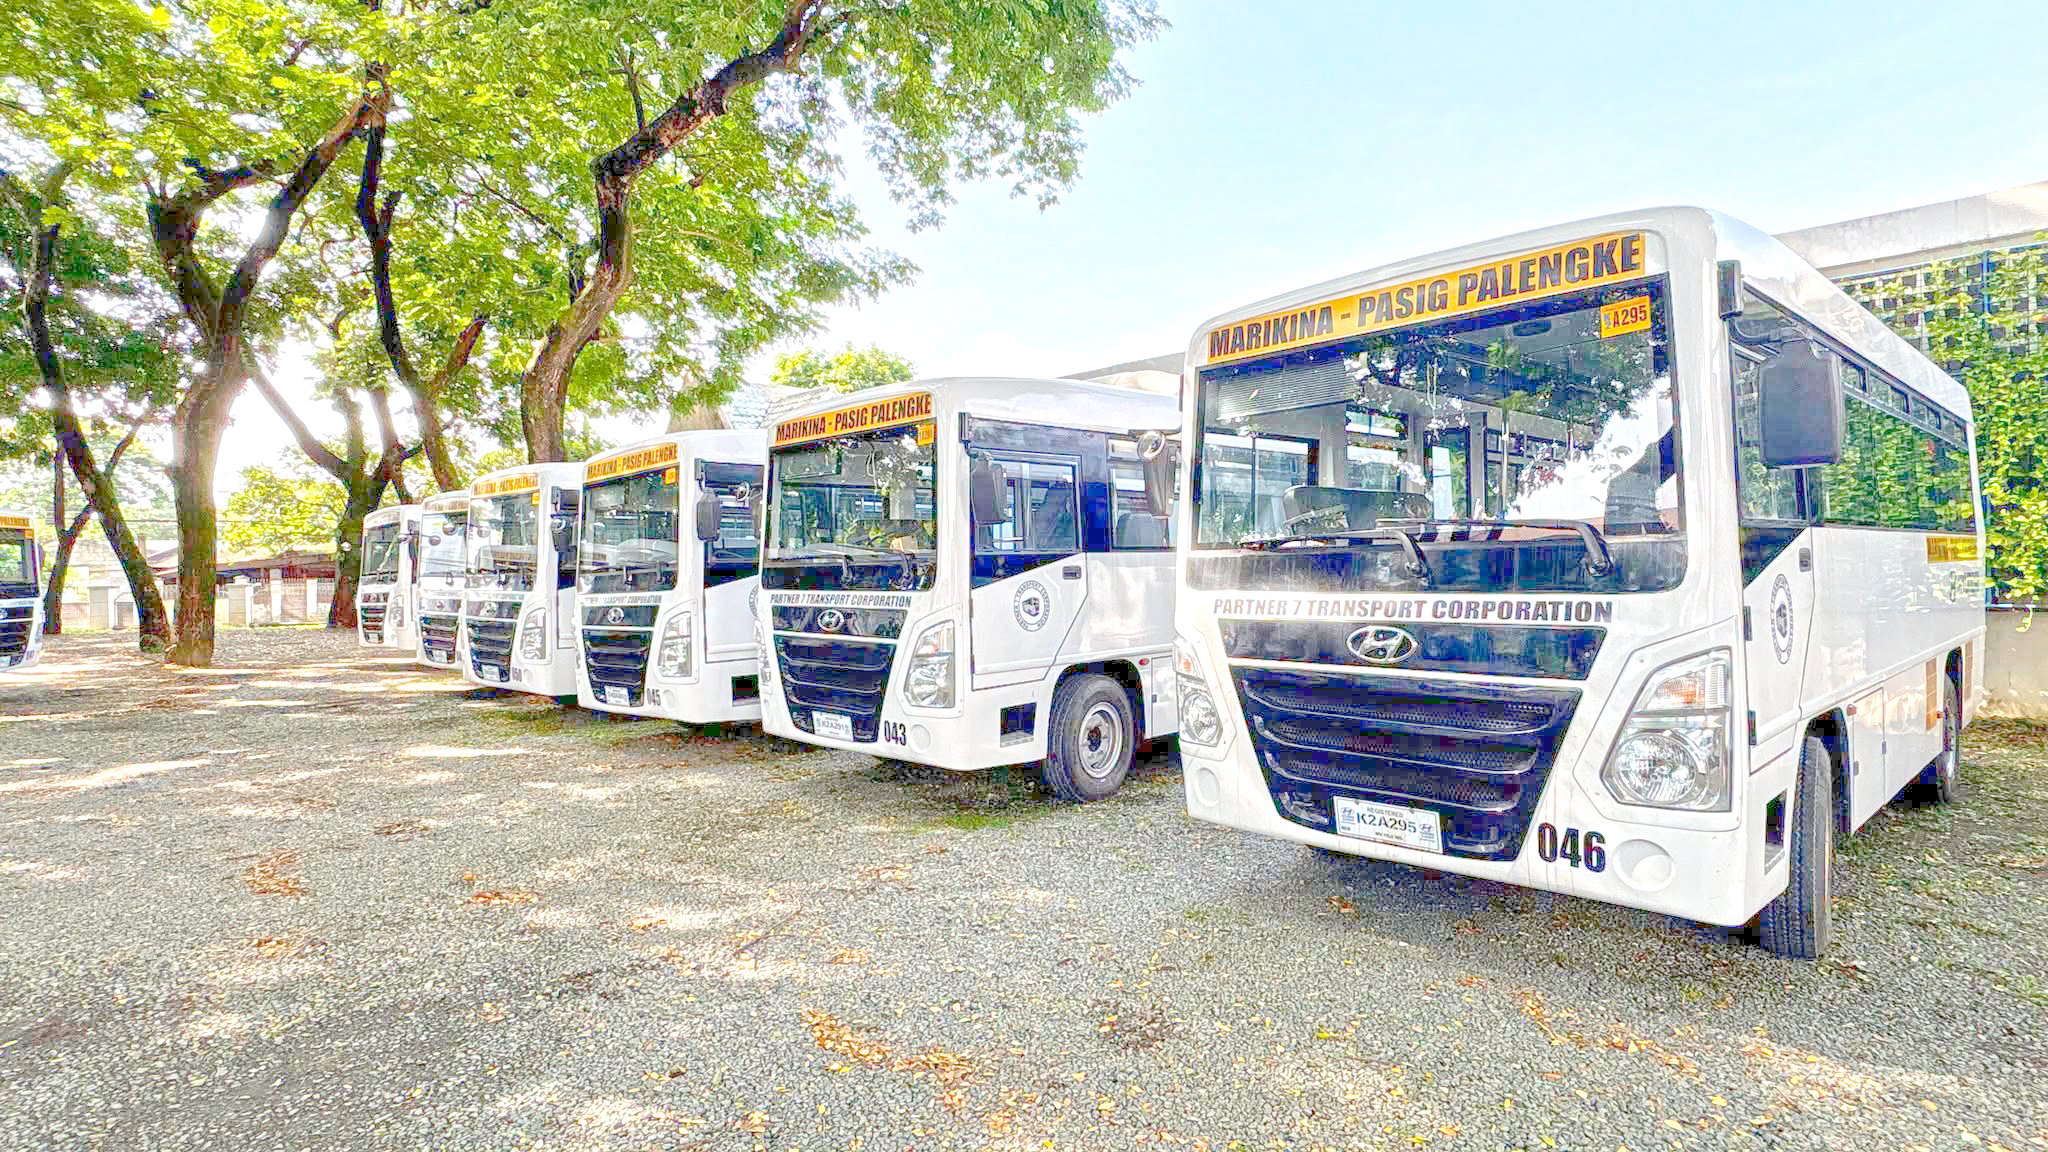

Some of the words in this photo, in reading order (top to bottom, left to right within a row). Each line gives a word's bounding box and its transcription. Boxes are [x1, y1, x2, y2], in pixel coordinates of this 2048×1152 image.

[1210, 305, 1334, 358] MARIKINA
[1358, 279, 1449, 328] PASIG
[1457, 232, 1641, 306] PALENGKE
[1613, 304, 1648, 328] A295
[776, 415, 826, 442] MARIKINA
[834, 407, 868, 431] PASIG
[870, 394, 932, 425] PALENGKE
[622, 453, 643, 471] PASIG
[643, 445, 678, 467] PALENGKE
[770, 593, 800, 604] PARTNER
[806, 594, 851, 606] TRANSPORT
[851, 595, 912, 608] CORPORATION
[1213, 599, 1287, 616] PARTNER
[1292, 600, 1301, 616] 7
[1307, 599, 1428, 619] TRANSPORT
[1431, 600, 1613, 623] CORPORATION
[646, 687, 661, 706] 045
[883, 719, 907, 746] 043
[1356, 812, 1417, 834] K2A295
[1366, 806, 1404, 819] REGISTERED
[1537, 822, 1607, 873] 046
